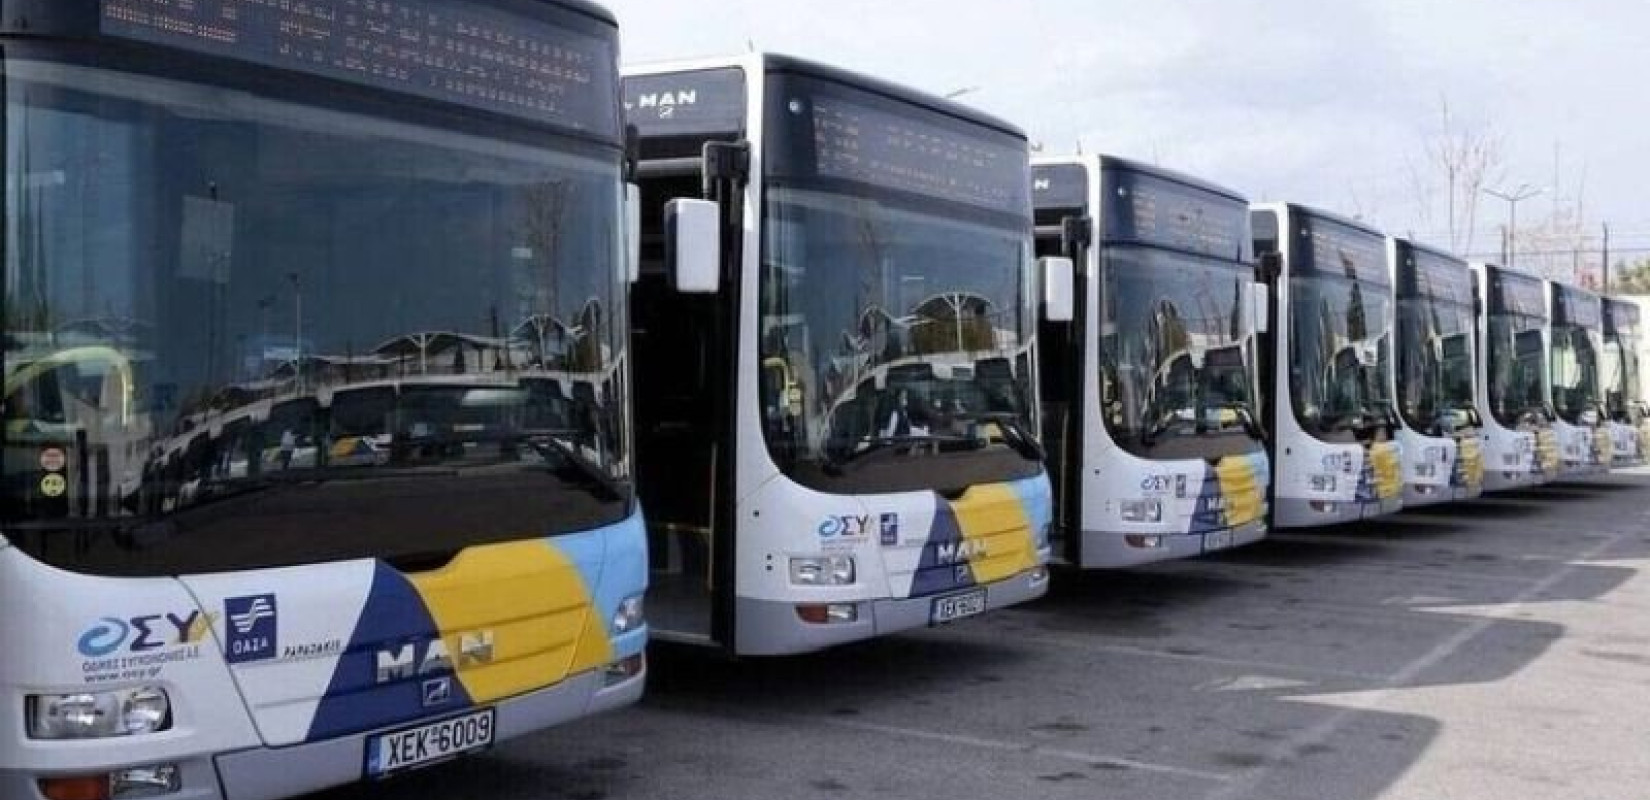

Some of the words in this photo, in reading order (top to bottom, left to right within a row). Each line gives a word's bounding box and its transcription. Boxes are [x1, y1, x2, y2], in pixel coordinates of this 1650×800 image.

[639, 89, 696, 108] MAN
[937, 541, 990, 565] MAN
[376, 629, 495, 684] MAN
